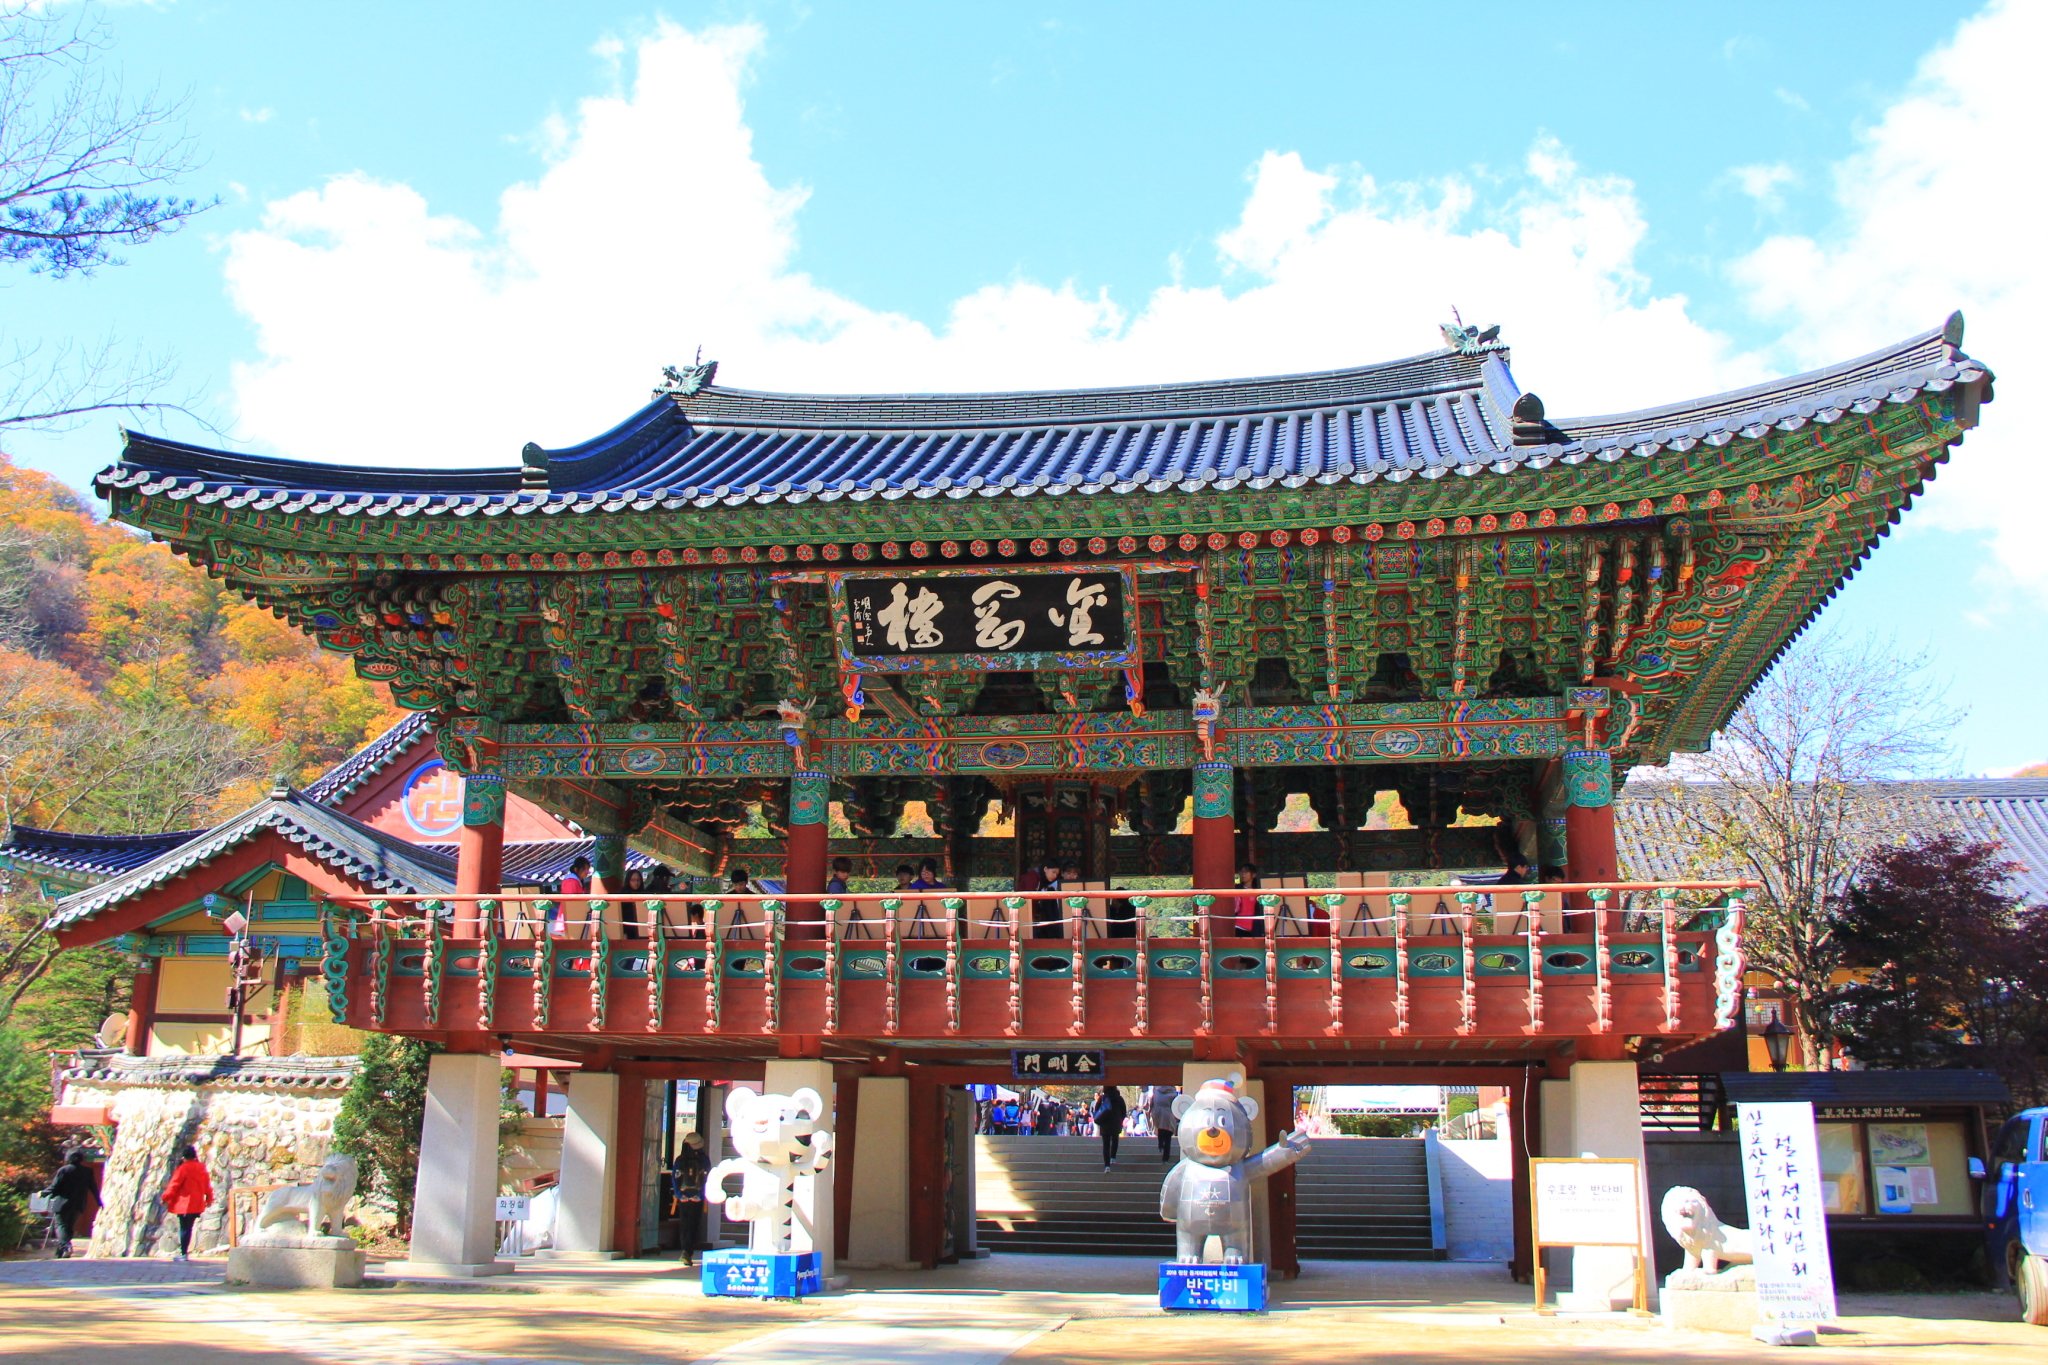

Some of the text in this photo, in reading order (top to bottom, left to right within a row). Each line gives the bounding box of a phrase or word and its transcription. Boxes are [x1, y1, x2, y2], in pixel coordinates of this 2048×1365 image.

[1024, 1054, 1097, 1073] 金剛門
[1823, 1107, 1858, 1117] 월정사
[1547, 1184, 1623, 1196] 수호랑 반다비
[500, 1200, 525, 1209] 화장실
[1774, 1132, 1808, 1276] 철야정진법회
[726, 1265, 771, 1284] 수호랑
[727, 1284, 769, 1293] Soohorang
[1186, 1278, 1238, 1296] 반다비
